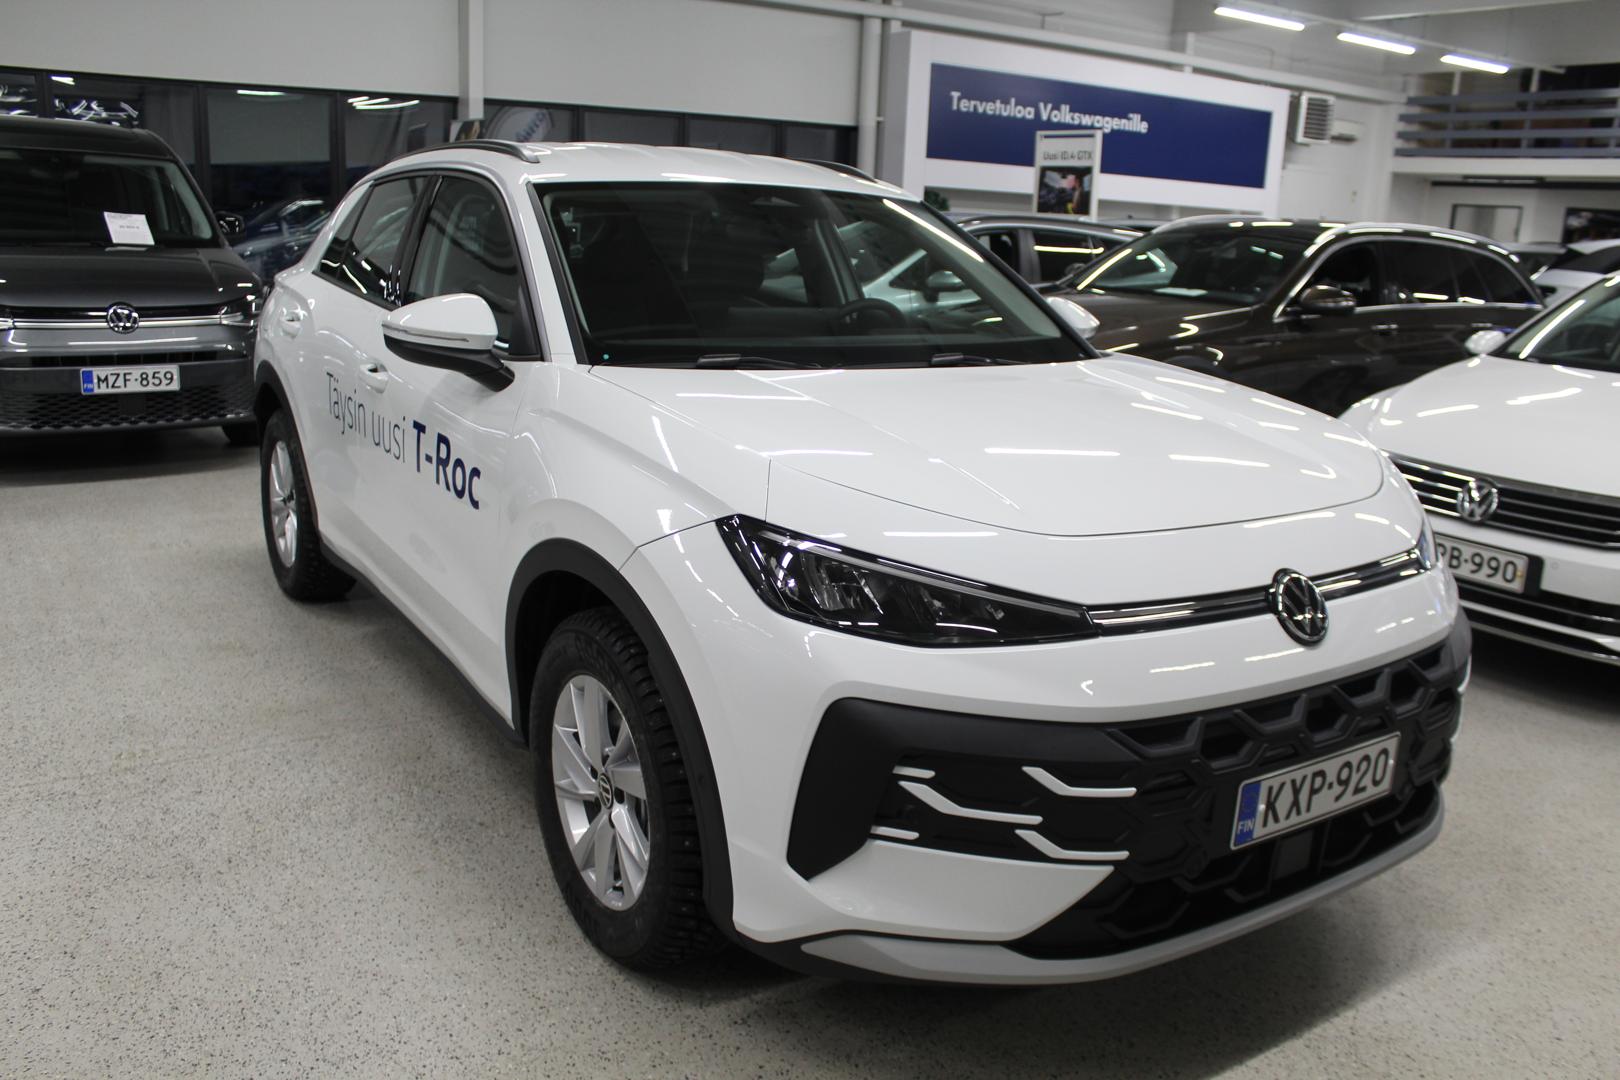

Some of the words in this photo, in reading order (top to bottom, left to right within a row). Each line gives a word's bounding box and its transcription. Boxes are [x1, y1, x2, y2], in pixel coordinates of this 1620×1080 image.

[950, 91, 1035, 120] Tervetuloa
[1039, 101, 1149, 134] Volkswagenille
[96, 370, 174, 390] MZF-859
[326, 371, 367, 438] Täysin
[371, 415, 406, 463] uusi
[412, 419, 481, 510] T-Roc
[1237, 818, 1256, 835] FIN
[1262, 747, 1390, 828] KXP-920
